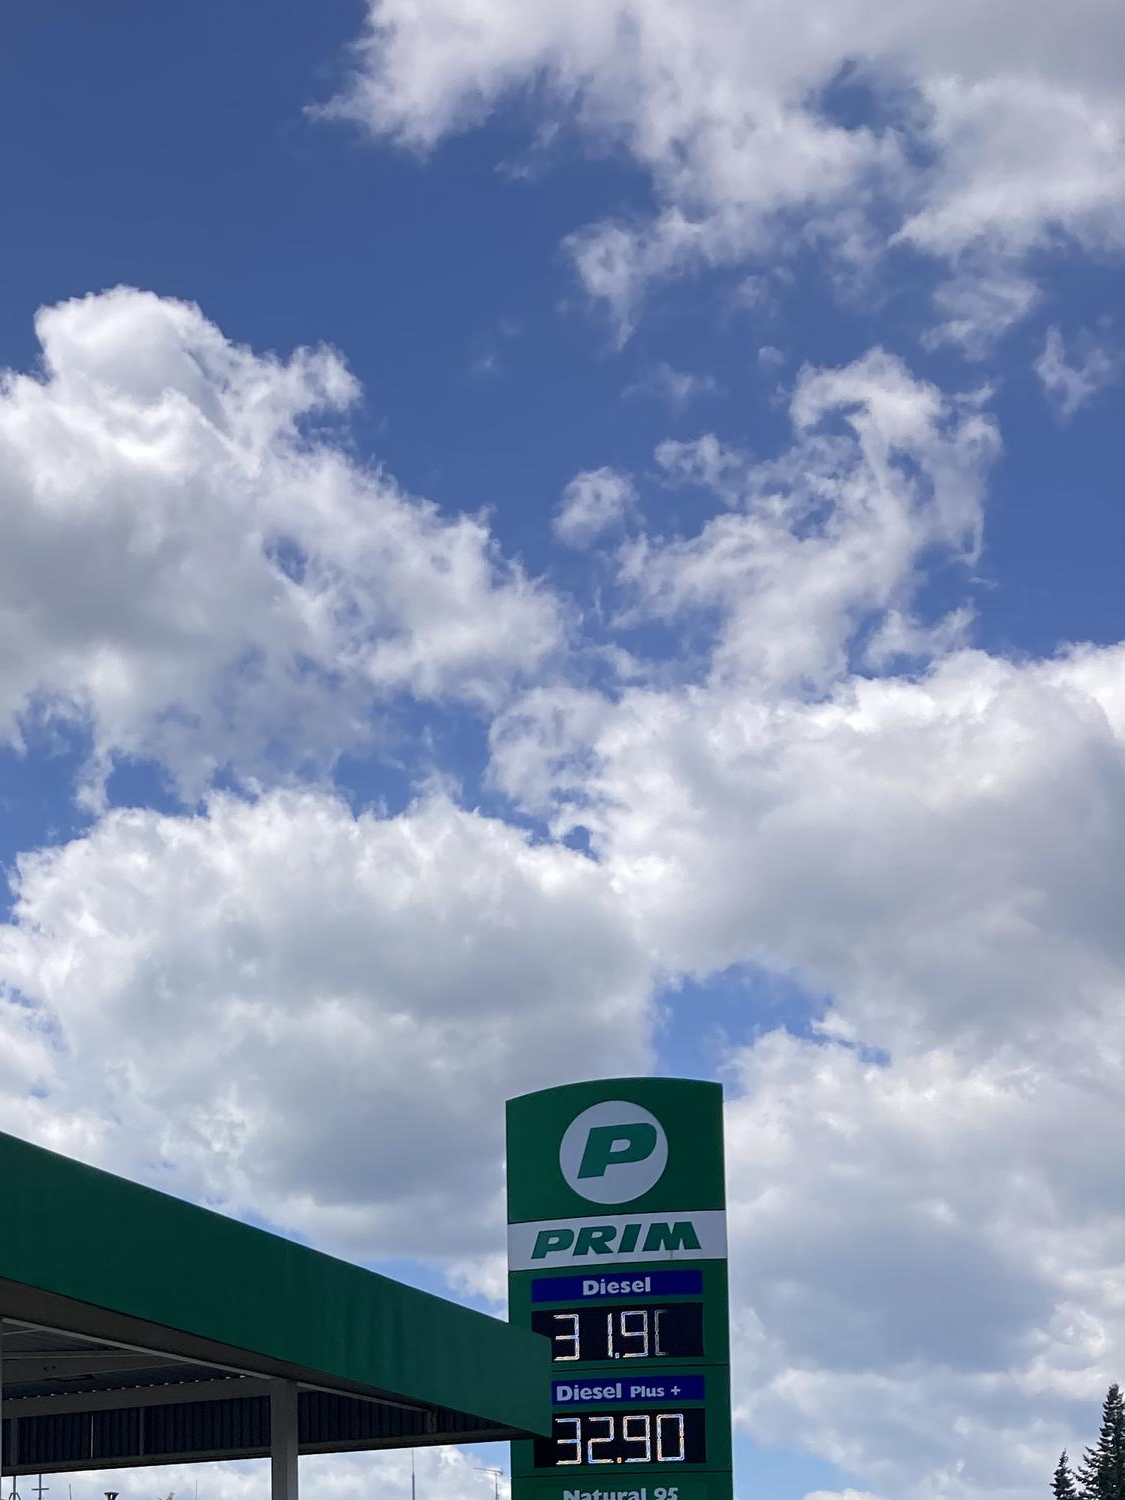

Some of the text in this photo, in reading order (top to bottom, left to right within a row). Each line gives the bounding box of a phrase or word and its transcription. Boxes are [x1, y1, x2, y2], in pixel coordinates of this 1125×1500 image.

[577, 1122, 658, 1180] P
[531, 1221, 702, 1260] PRIM
[582, 1277, 652, 1297] Diesel
[556, 1383, 682, 1401] Diesel Plus +
[555, 1413, 685, 1465] 32.90
